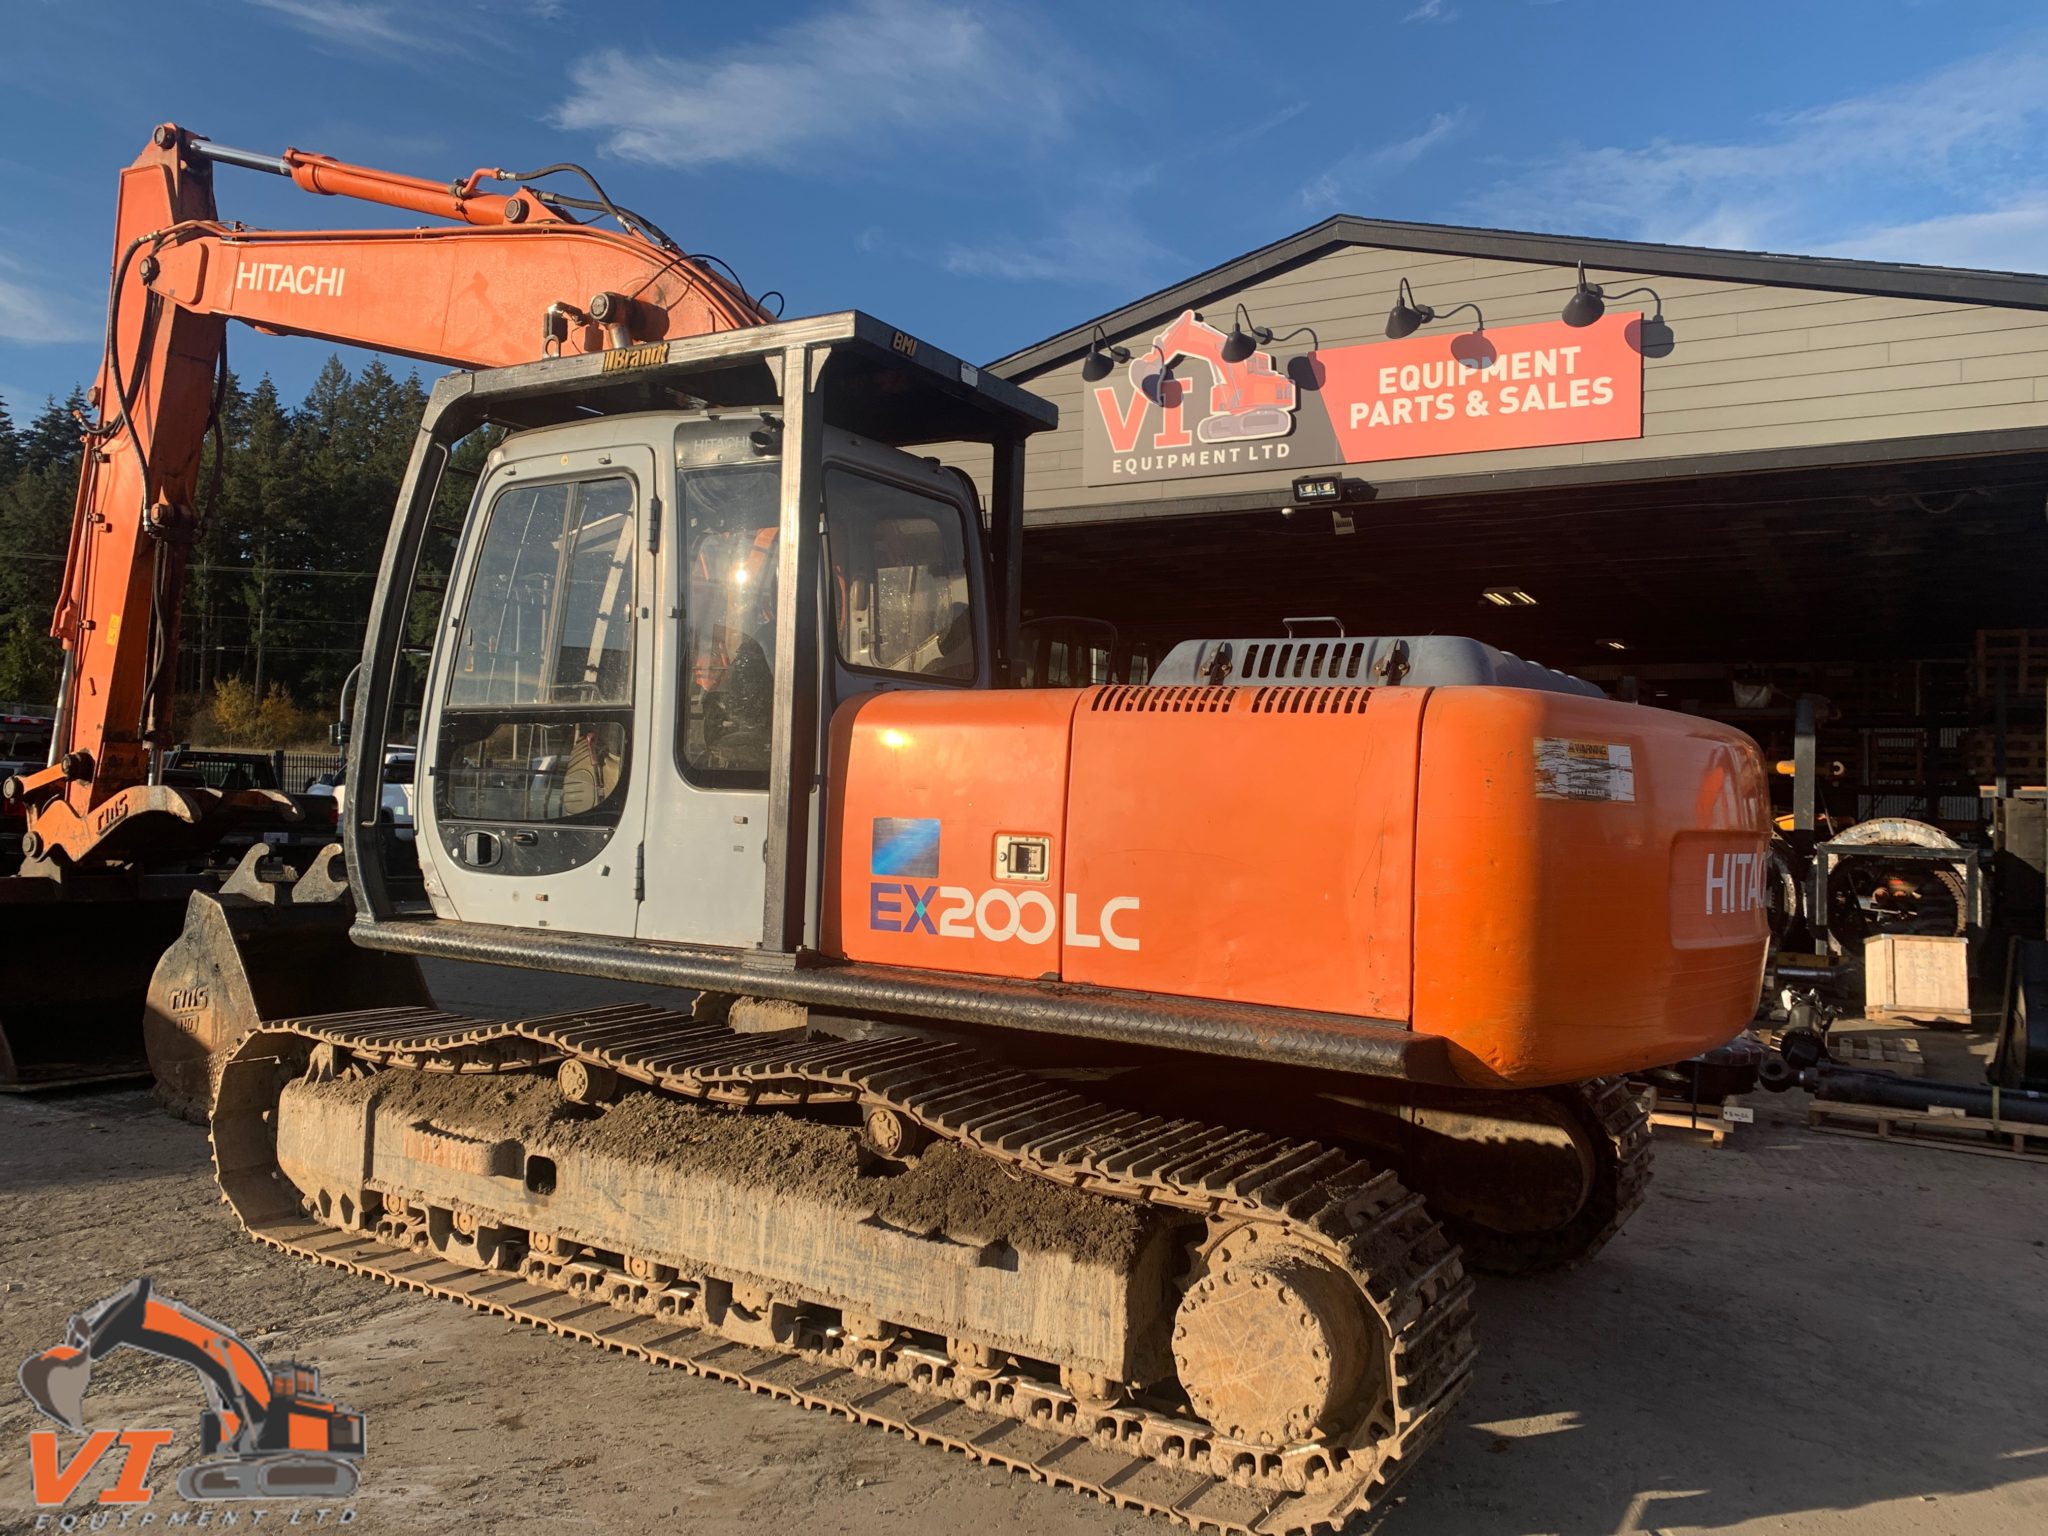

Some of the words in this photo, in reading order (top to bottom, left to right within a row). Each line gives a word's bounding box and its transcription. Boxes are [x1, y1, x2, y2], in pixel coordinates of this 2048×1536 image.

[236, 261, 345, 297] HITACHI
[893, 331, 918, 357] BMI
[1379, 346, 1581, 395] EQUIPMENT
[1093, 376, 1194, 454] VI
[1350, 393, 1455, 430] PARTS
[1465, 390, 1490, 418] &
[1499, 376, 1614, 415] SALES
[694, 436, 752, 452] HITACHI
[1112, 448, 1240, 475] EQUIPMENT
[1249, 443, 1290, 461] LTD
